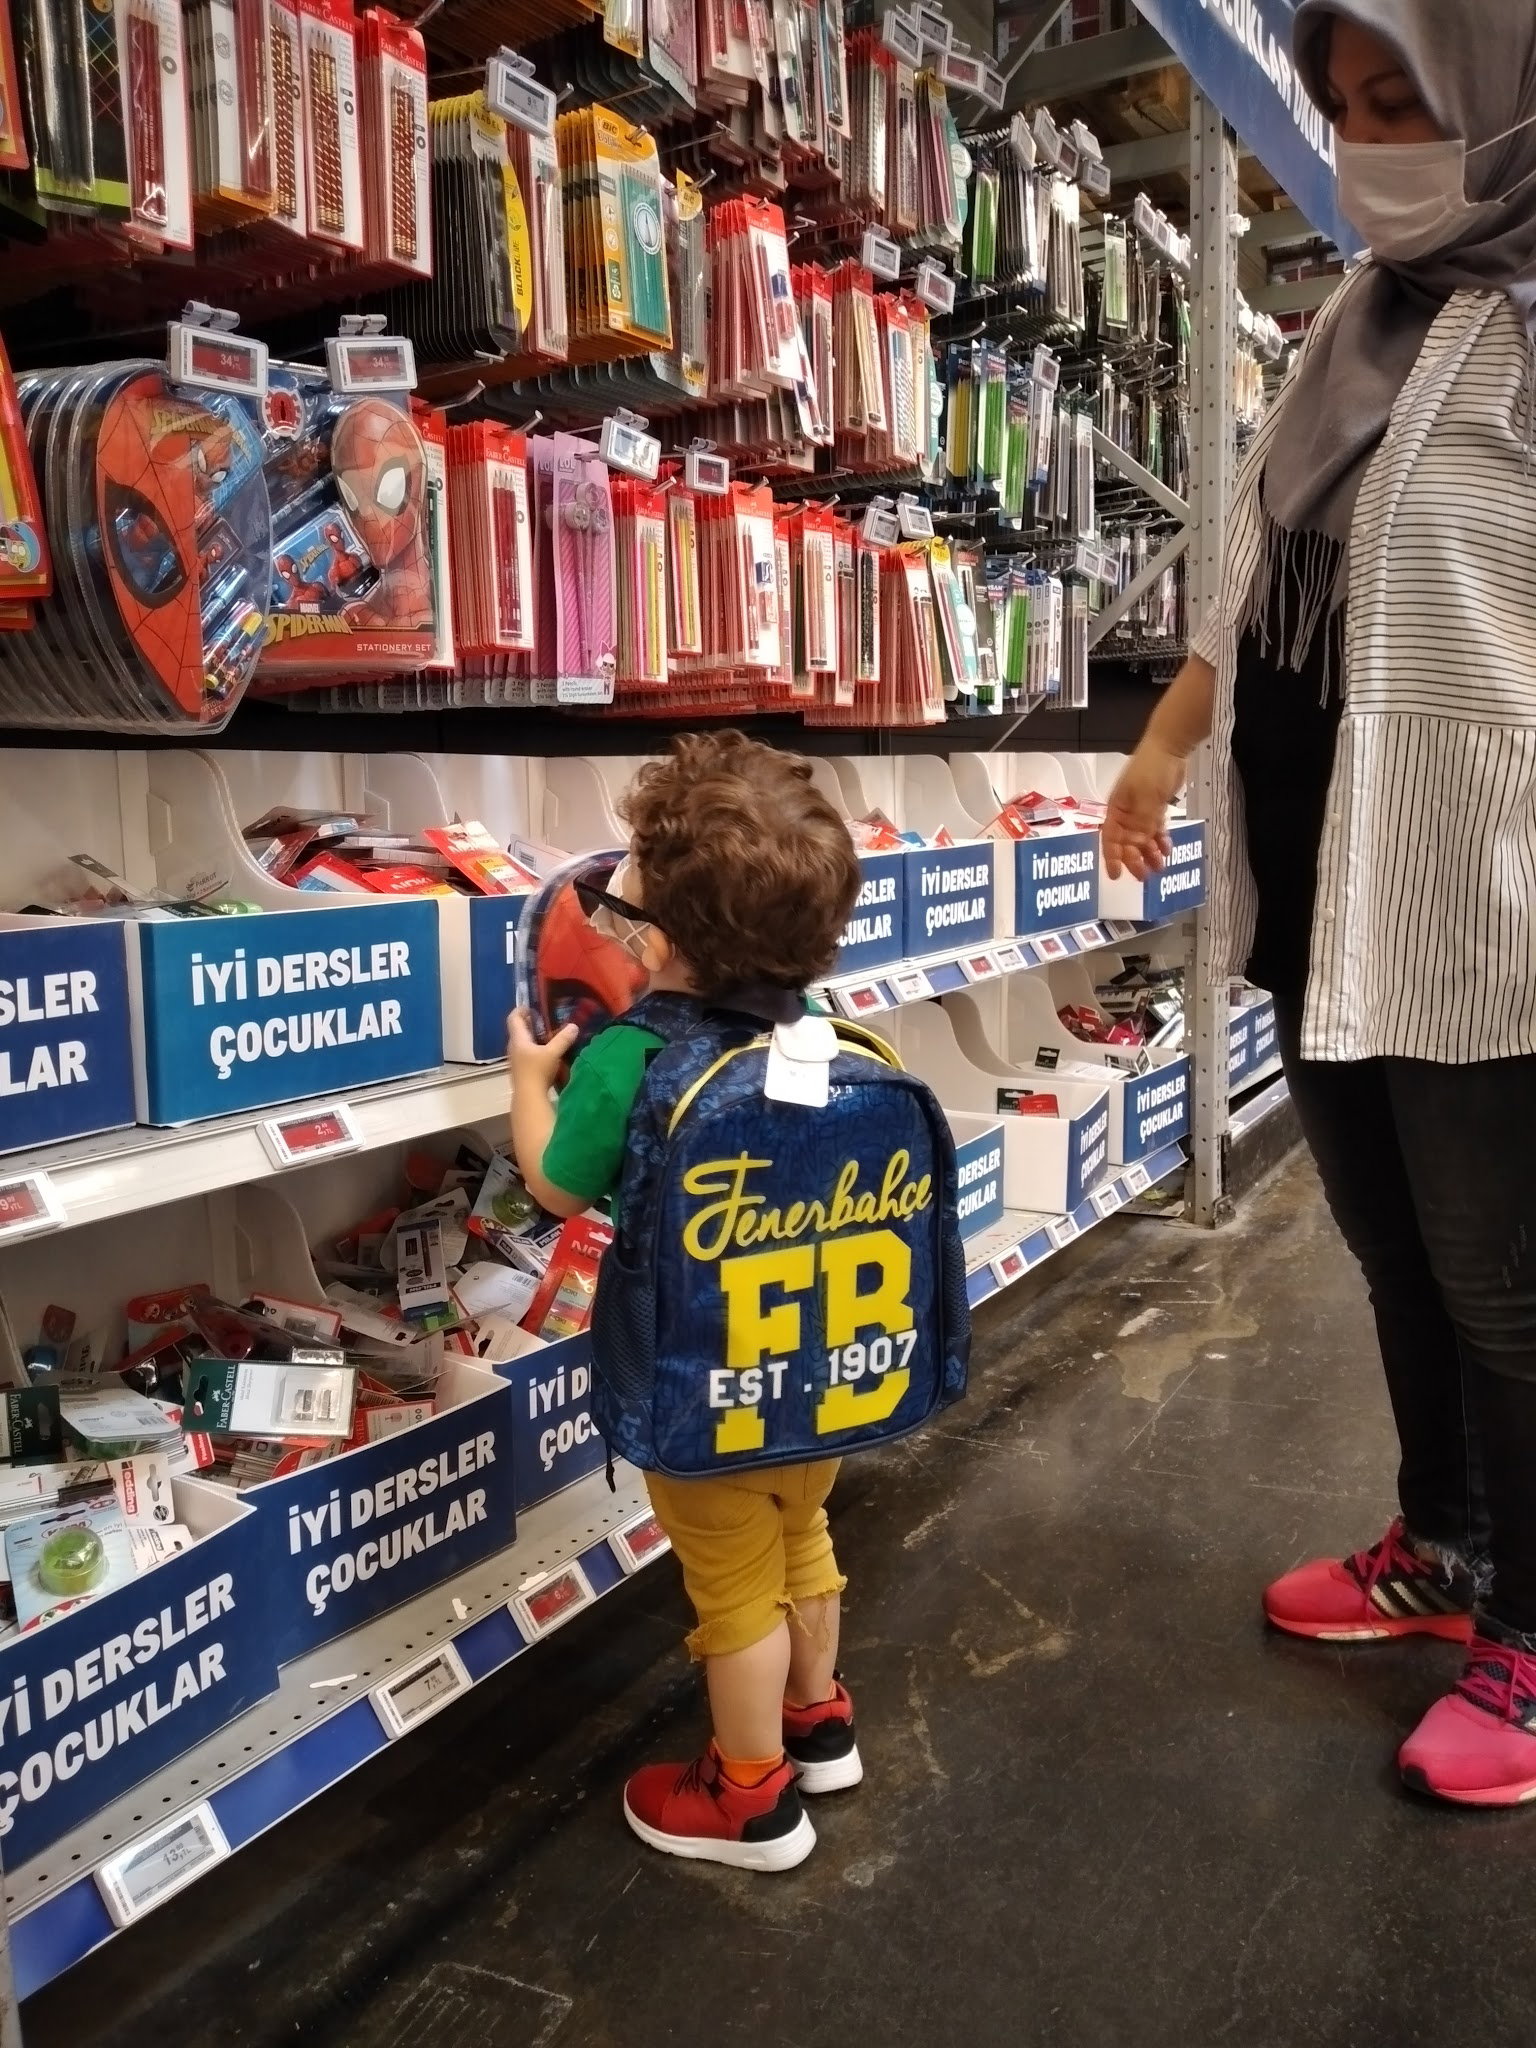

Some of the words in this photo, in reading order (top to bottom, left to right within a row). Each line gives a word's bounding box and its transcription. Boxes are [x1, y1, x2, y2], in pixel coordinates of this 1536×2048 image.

[299, 603, 321, 614] MARVEL
[356, 643, 413, 652] STATIONERY
[415, 643, 431, 651] SET
[1032, 851, 1049, 881] İYİ
[1051, 850, 1094, 878] DERSLER
[1171, 840, 1202, 866] DERSLER
[921, 865, 940, 897] İYİ
[942, 864, 989, 894] DERSLER
[1036, 881, 1090, 917] ÇOCUKLAR
[1160, 868, 1201, 903] ÇOCUKLAR
[925, 897, 986, 937] ÇOCUKLAR
[191, 949, 248, 1006] İYİ
[257, 941, 411, 998] DERSLER
[210, 999, 402, 1080] ÇOCUKLAR
[1136, 1086, 1150, 1114] İYİ
[1150, 1075, 1186, 1107] DERSLER
[1139, 1101, 1184, 1145] ÇOCUKLAR
[958, 1148, 1001, 1189] DERSLER
[683, 1148, 933, 1261] Fenerbahçe
[828, 1329, 917, 1385] 1907
[216, 1364, 236, 1429] FABER-CASTELL
[529, 1365, 565, 1420] İYİ
[125, 1470, 136, 1513] edding
[289, 1489, 341, 1555] İYİ
[350, 1431, 496, 1529] DERSLER
[306, 1488, 487, 1616] ÇOCUKLAR
[42, 1572, 235, 1721] DERSLER
